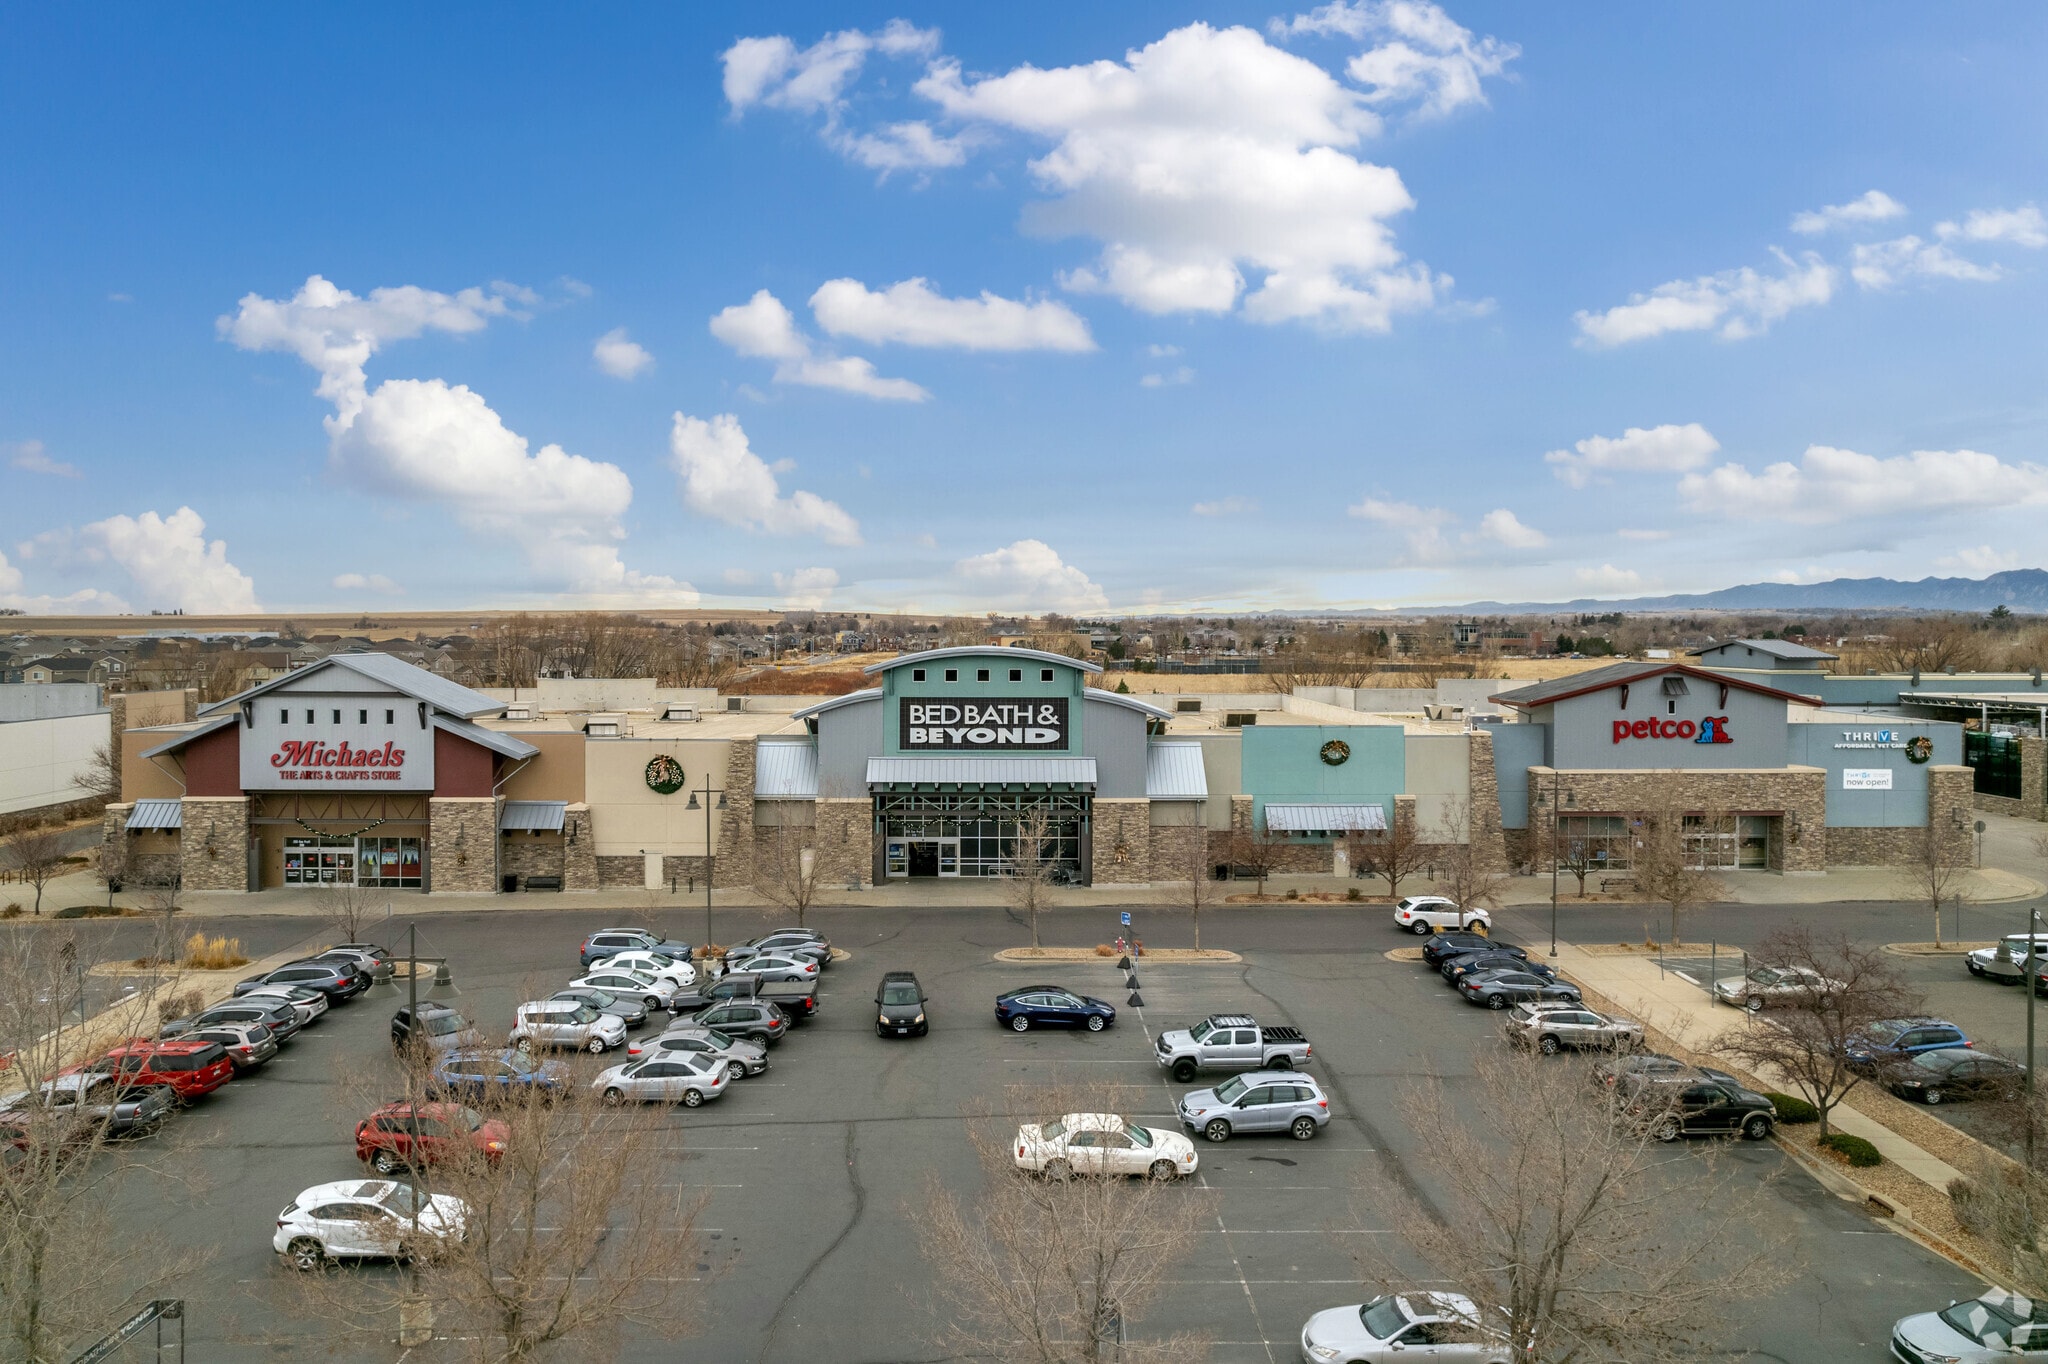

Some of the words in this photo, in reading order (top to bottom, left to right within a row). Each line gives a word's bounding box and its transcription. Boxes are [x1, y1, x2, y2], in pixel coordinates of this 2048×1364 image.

[909, 704, 962, 725] BED
[964, 704, 1033, 725] BATH
[1037, 704, 1060, 725] &
[909, 727, 1060, 744] BEYOND
[1613, 716, 1696, 744] petco
[1843, 730, 1899, 743] THRIVE
[270, 741, 405, 768] Michaels
[279, 770, 299, 781] THE
[299, 770, 323, 781] ARTS
[325, 770, 333, 781] &
[334, 770, 370, 781] CRAFTS
[371, 770, 401, 781] STORE
[1865, 779, 1889, 787] open!
